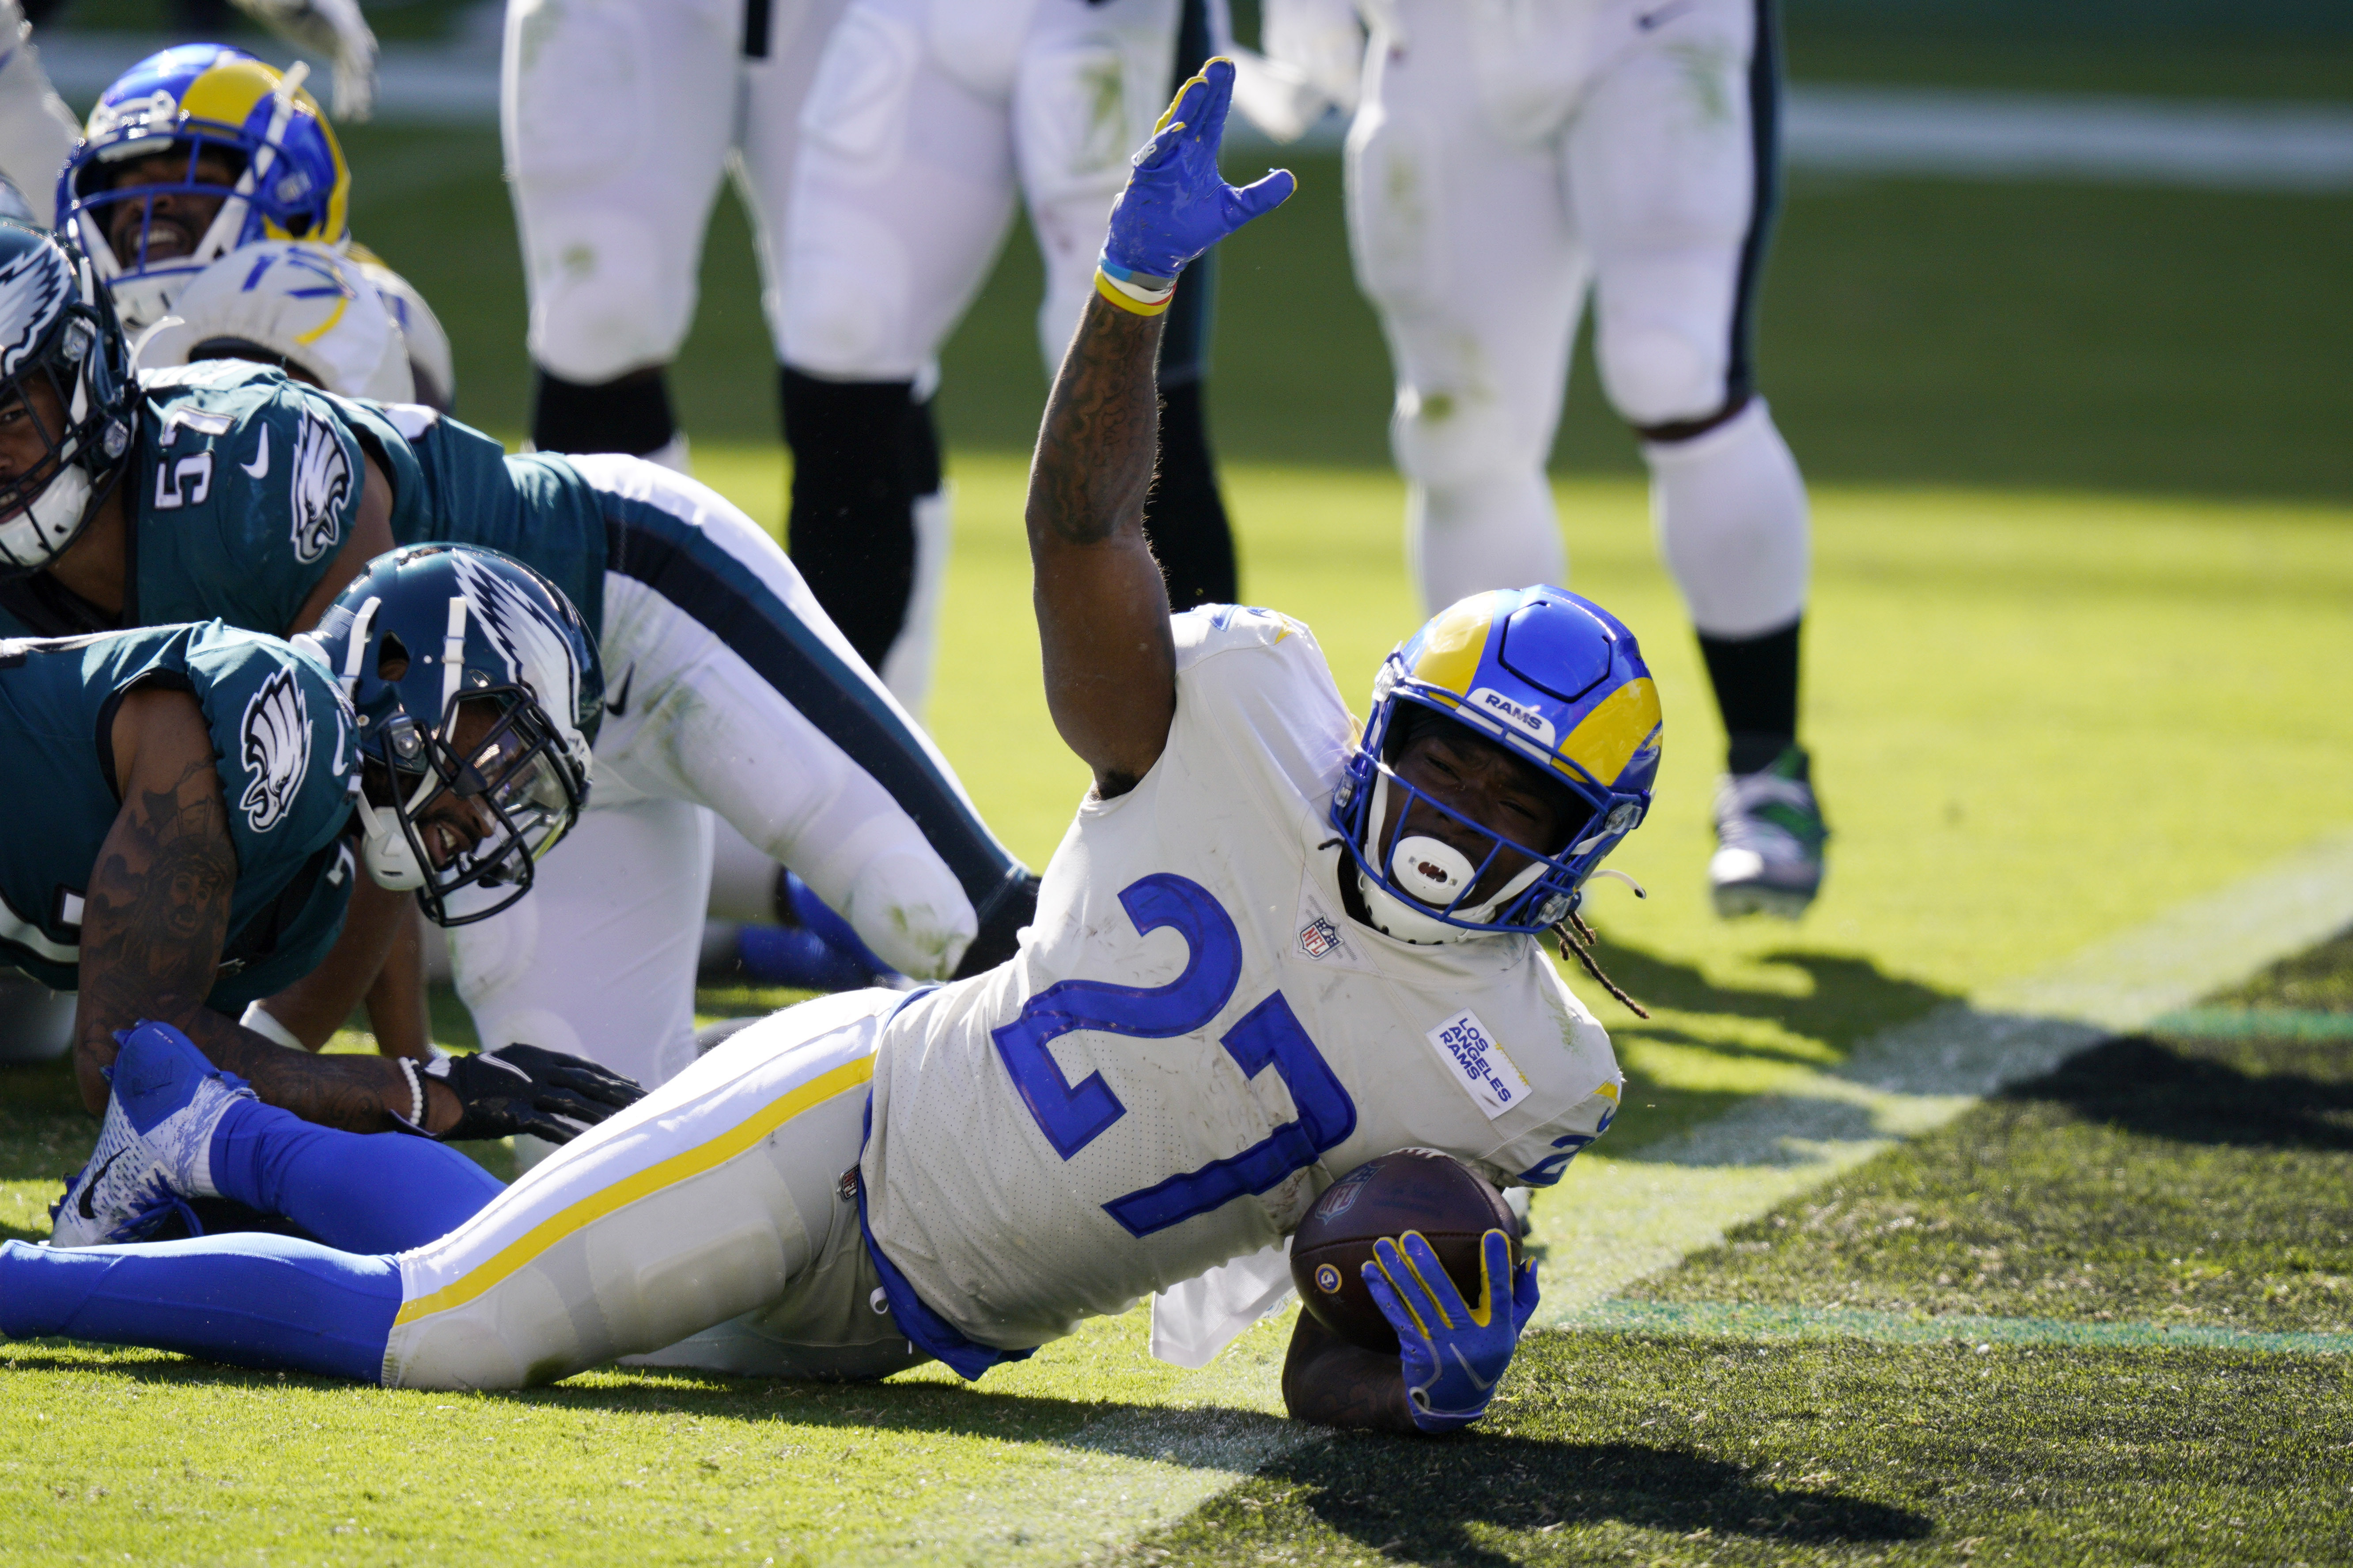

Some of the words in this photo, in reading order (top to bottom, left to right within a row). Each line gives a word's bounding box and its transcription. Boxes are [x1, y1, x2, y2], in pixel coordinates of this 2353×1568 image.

[155, 406, 235, 509] 57
[1485, 694, 1542, 730] RAMS
[1302, 927, 1326, 955] NFL
[991, 872, 1358, 1239] 27
[1439, 1030, 1481, 1080] RAMS
[1458, 1017, 1489, 1052] LOS
[1449, 1026, 1512, 1102] ANGELES
[1319, 1184, 1357, 1213] NFL
